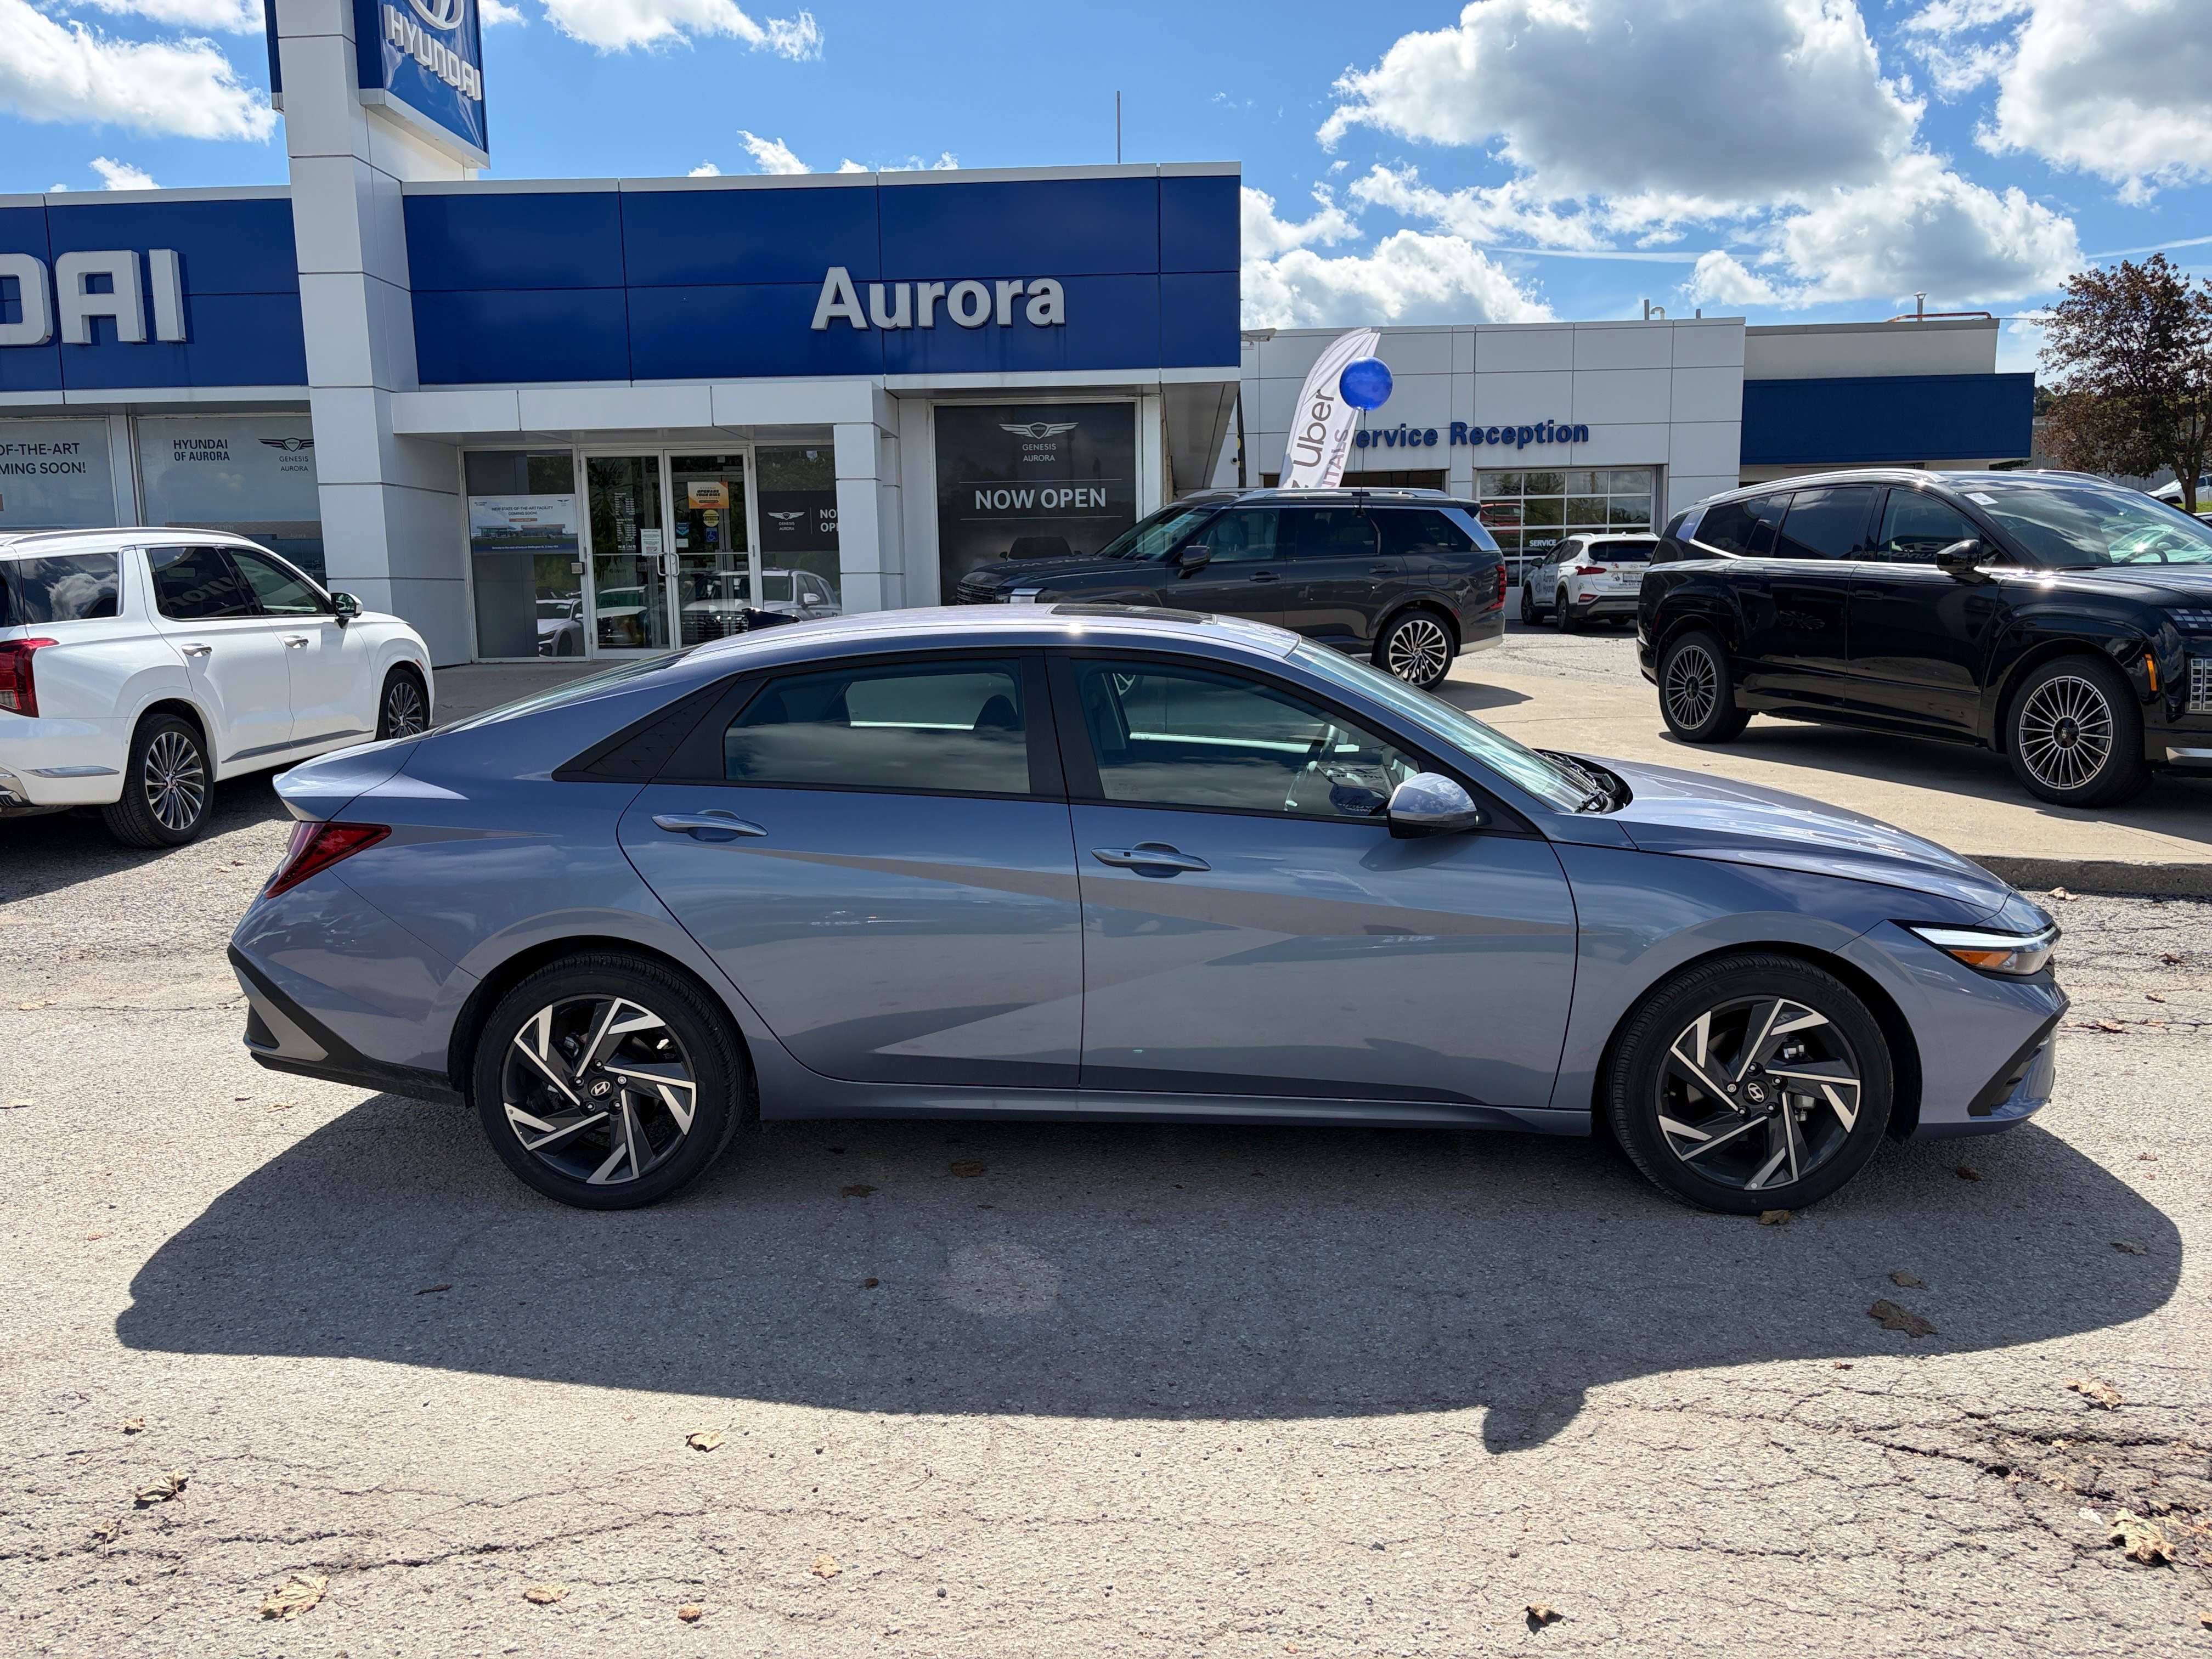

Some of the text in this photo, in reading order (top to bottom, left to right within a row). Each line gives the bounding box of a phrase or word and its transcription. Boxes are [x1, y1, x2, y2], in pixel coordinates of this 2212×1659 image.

[384, 4, 482, 101] HYUNDAI
[810, 266, 1065, 330] Aurora
[1293, 388, 1335, 468] Uber
[1351, 420, 1589, 449] ervice Reception
[173, 439, 228, 450] HYUNDAI
[174, 451, 230, 461] OF AURORA
[40, 461, 86, 474] SOON!
[975, 488, 1107, 510] NOW OPEN
[820, 509, 838, 519] NO
[1529, 539, 1557, 548] SERVICE
